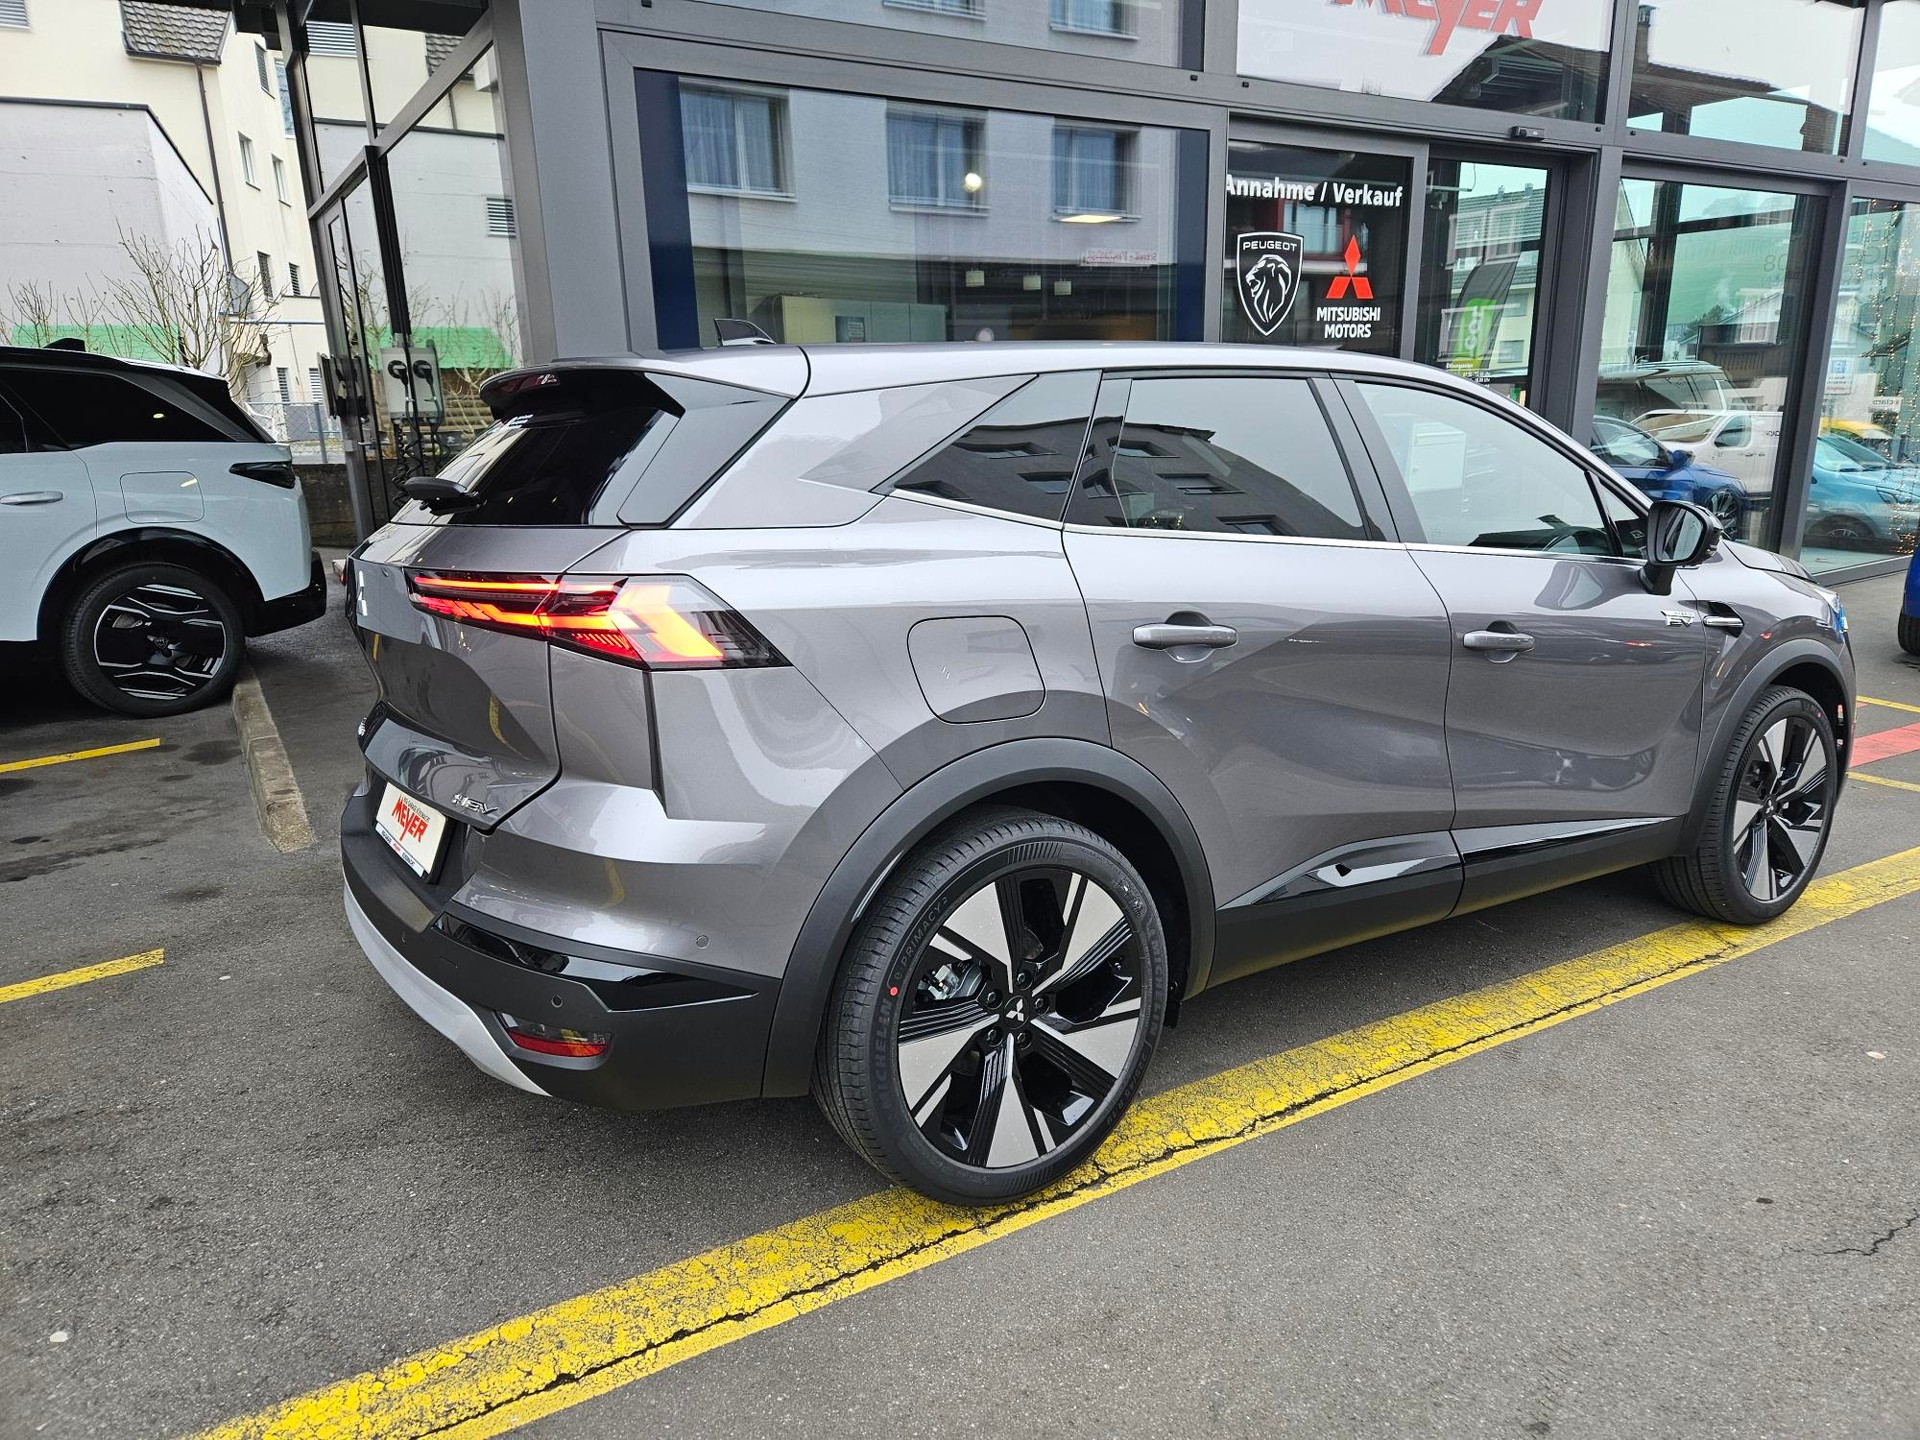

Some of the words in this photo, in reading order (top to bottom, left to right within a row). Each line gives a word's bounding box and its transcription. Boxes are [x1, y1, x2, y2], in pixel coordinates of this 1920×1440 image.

[1331, 0, 1542, 56] YER
[1225, 174, 1315, 201] Annahme
[1320, 182, 1327, 202] /
[1333, 183, 1403, 207] Verkauf
[1242, 240, 1298, 252] PEUGEOT
[1316, 307, 1381, 322] MITSUBISHI
[1324, 323, 1372, 339] MOTORS
[391, 796, 429, 843] MEYER
[901, 901, 941, 967] PRIMACY
